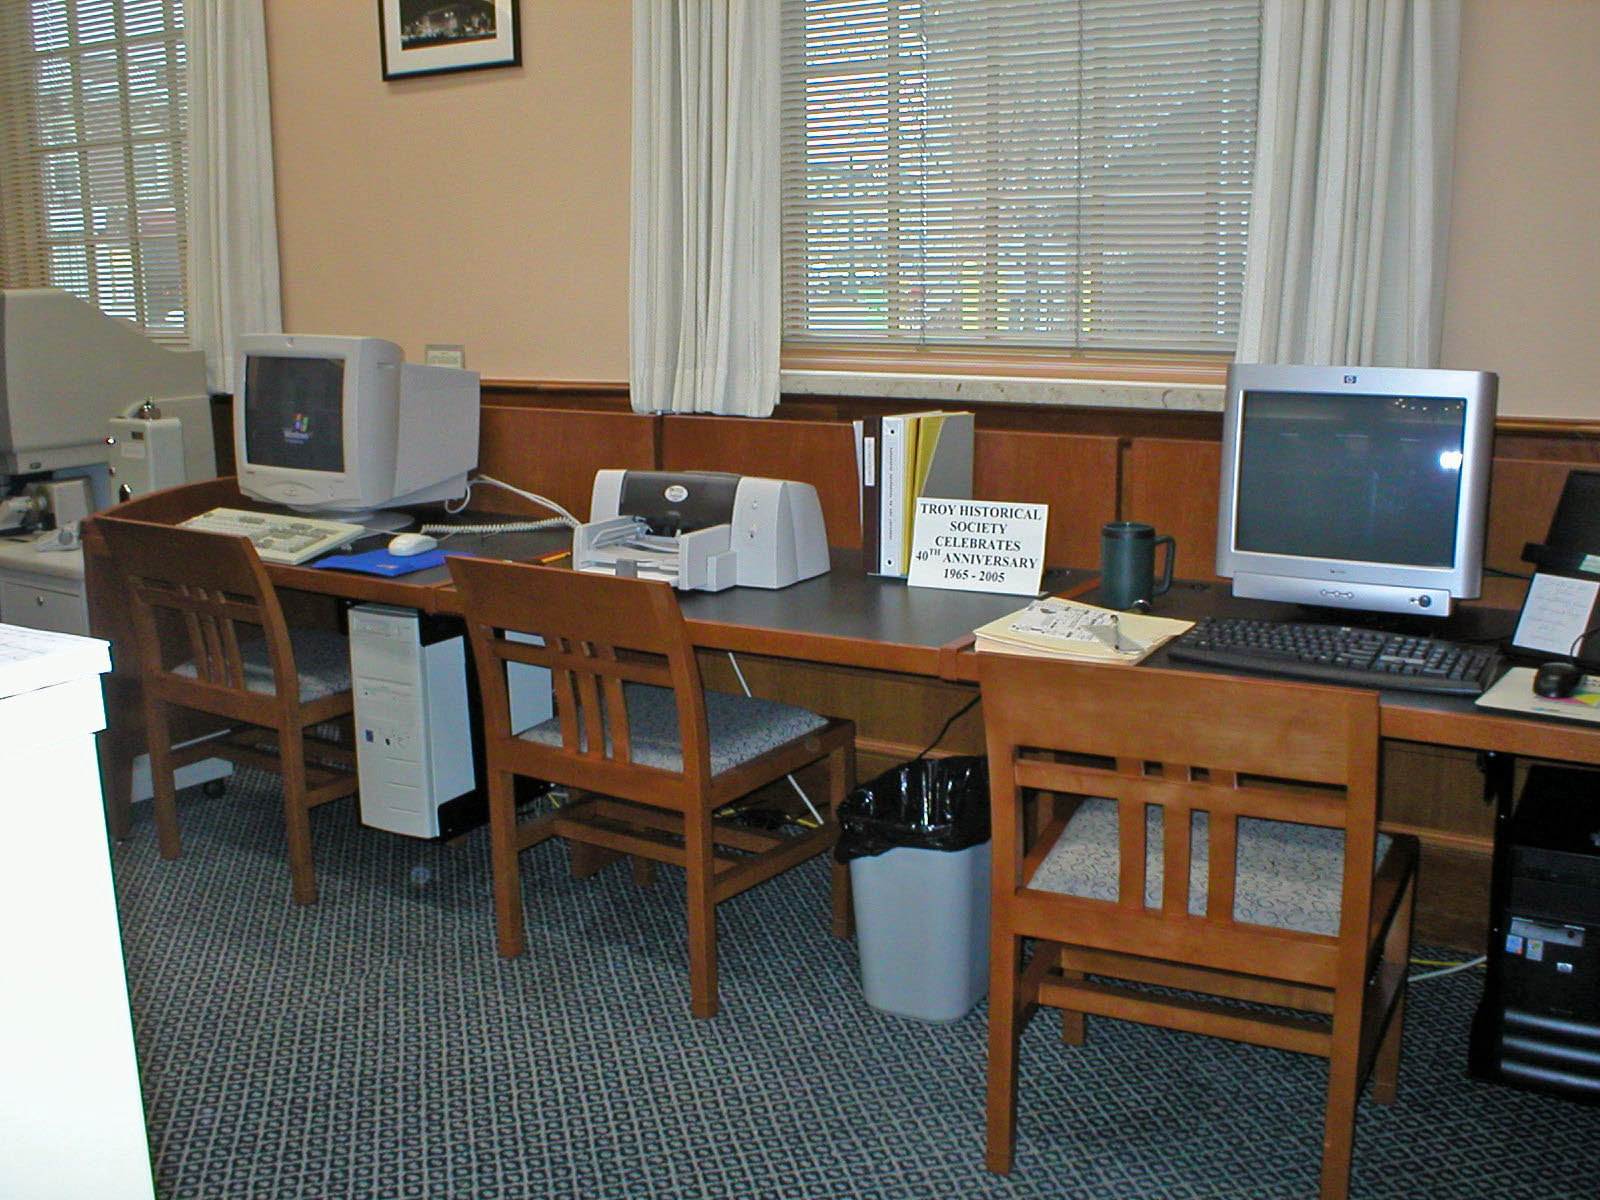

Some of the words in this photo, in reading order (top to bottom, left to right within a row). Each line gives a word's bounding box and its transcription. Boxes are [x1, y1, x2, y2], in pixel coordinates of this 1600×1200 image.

[920, 503, 957, 516] TROY
[959, 505, 1042, 521] HISTORICAL
[949, 521, 1008, 534] SOCIETY
[935, 536, 1021, 551] CELEBRATES
[942, 553, 1039, 569] ANNIVERSARY
[944, 568, 969, 580] 1965
[978, 570, 1006, 583] 2005
